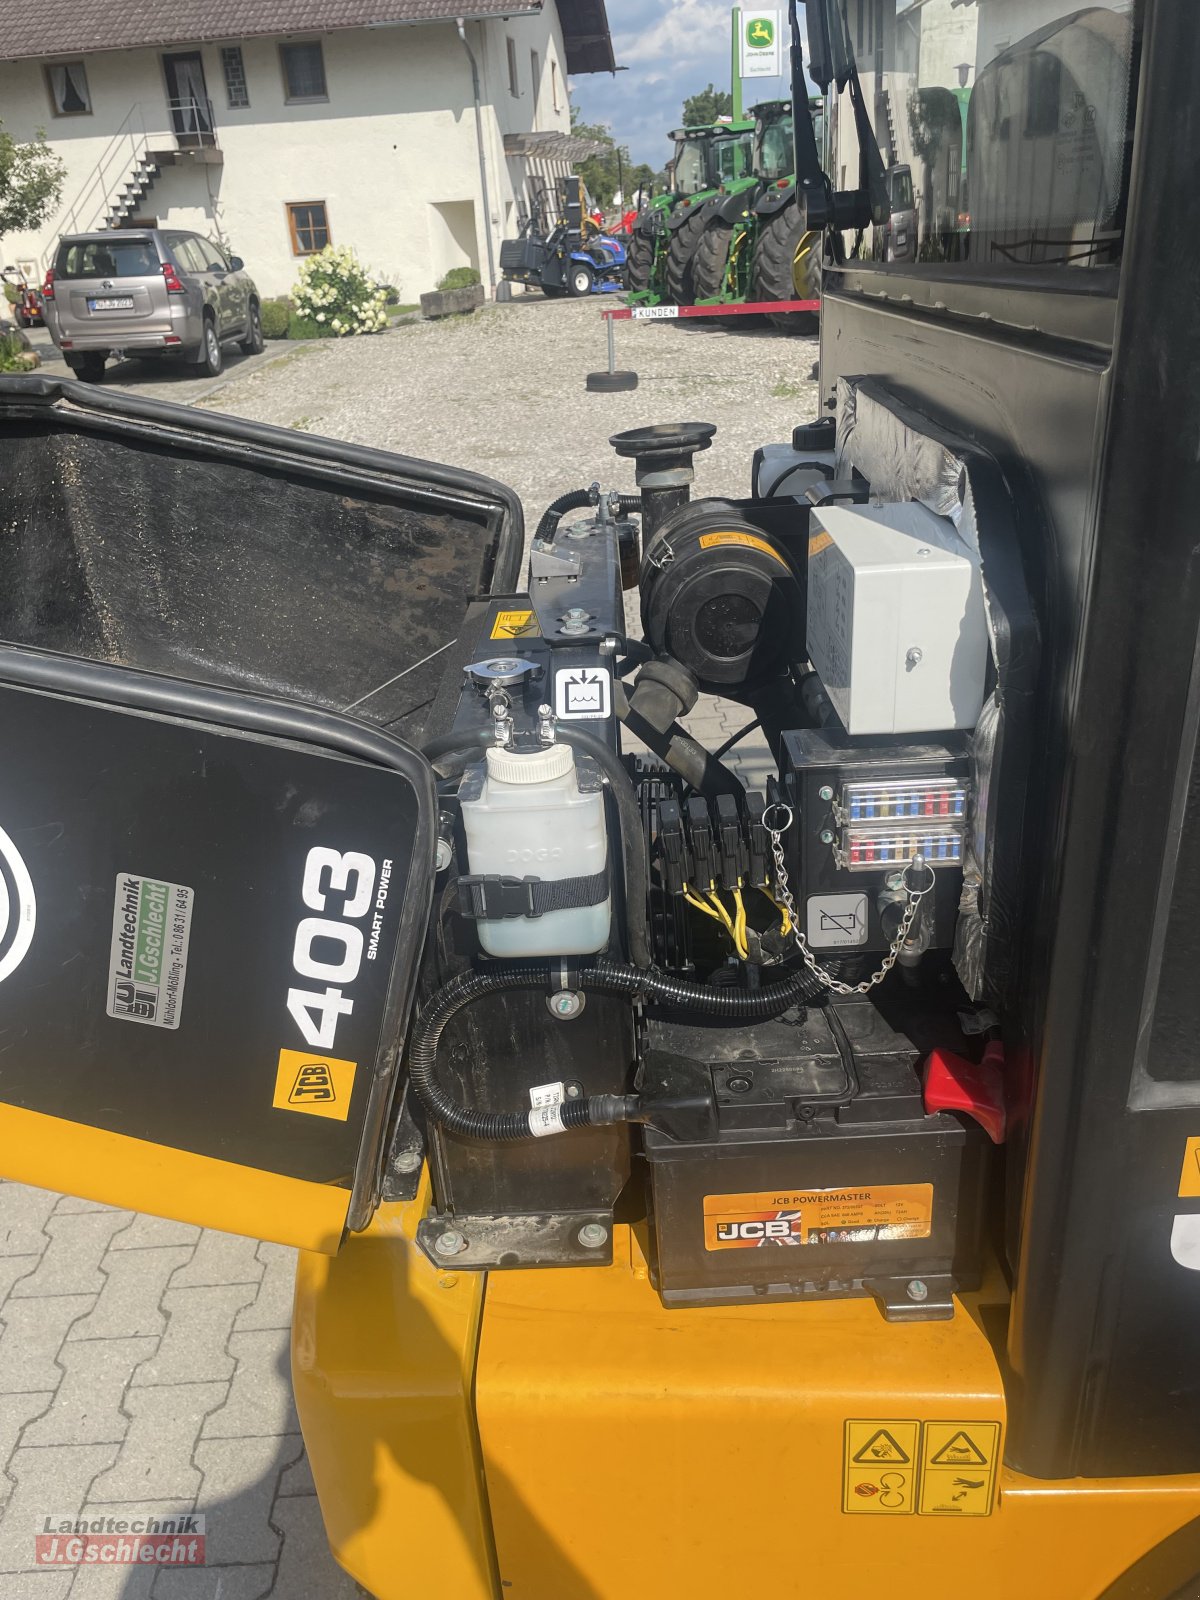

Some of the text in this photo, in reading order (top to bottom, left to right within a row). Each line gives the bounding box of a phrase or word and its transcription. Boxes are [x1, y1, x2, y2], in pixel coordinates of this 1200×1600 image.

[639, 308, 675, 317] KUNDEN
[116, 877, 140, 979] Landtechnik
[138, 883, 166, 983] J.Gschlecht
[367, 859, 393, 960] SMART POWER
[287, 846, 376, 1049] 403
[163, 962, 183, 1025] Mühldorf-Mößling
[294, 1066, 332, 1099] JCB
[793, 1193, 872, 1204] POWERMASTER
[719, 1221, 790, 1240] JCB
